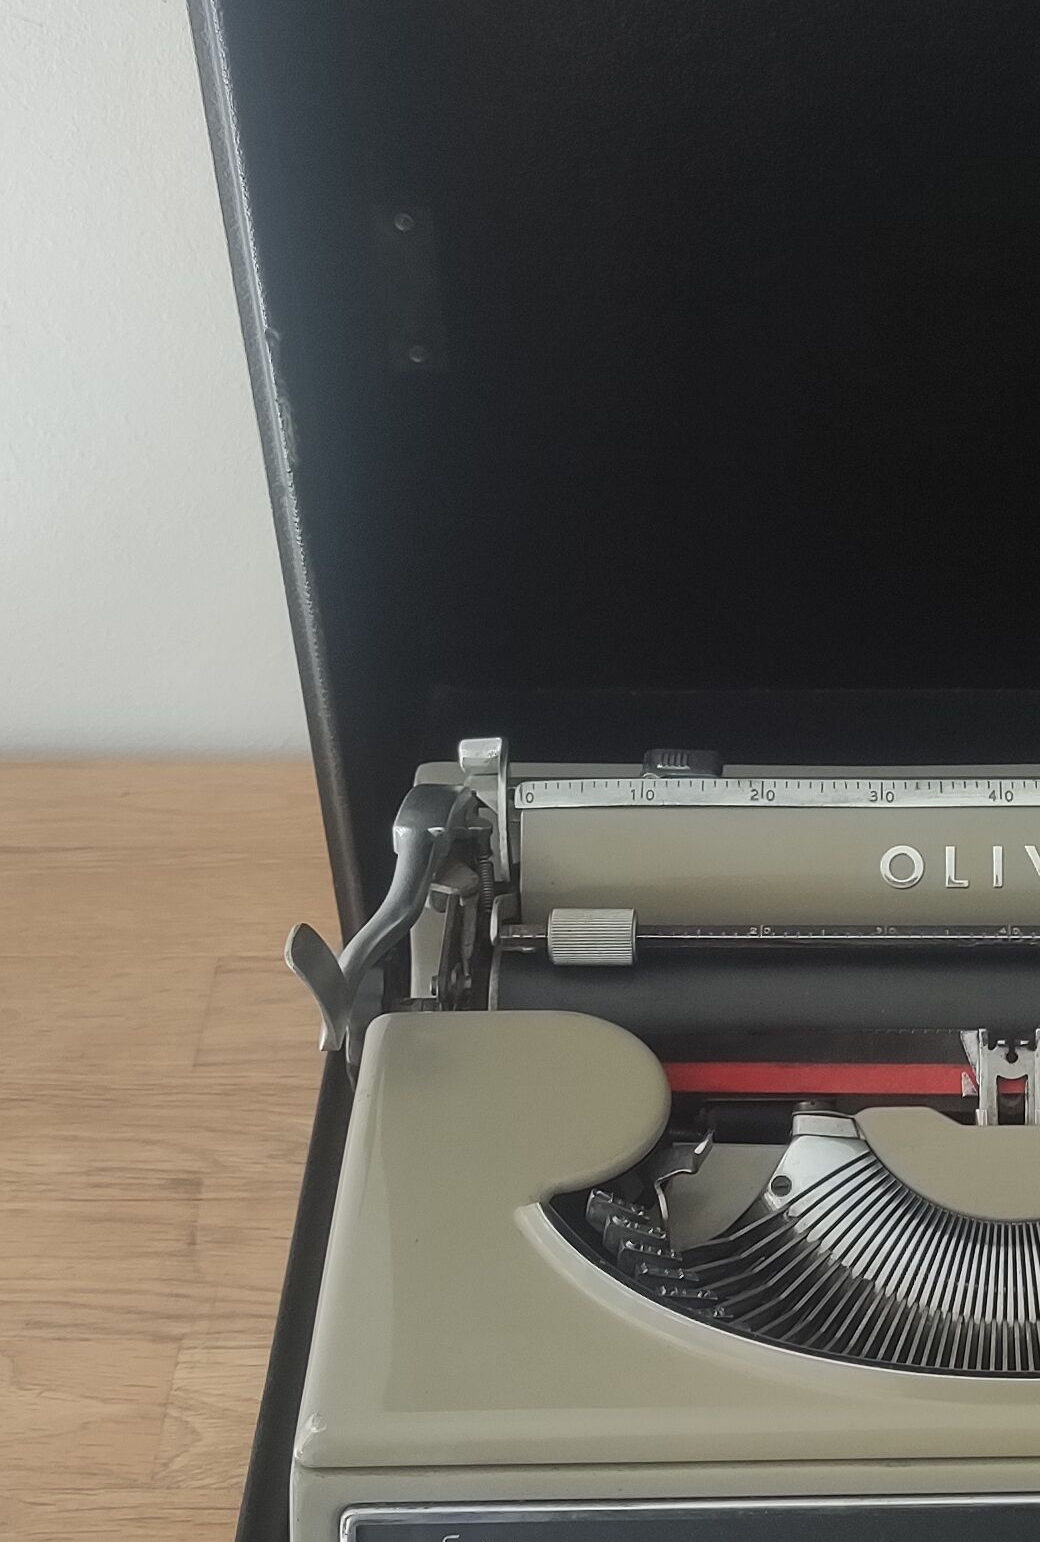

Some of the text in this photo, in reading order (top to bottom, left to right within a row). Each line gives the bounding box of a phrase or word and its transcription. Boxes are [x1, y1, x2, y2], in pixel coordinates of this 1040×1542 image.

[526, 792, 534, 803] 0
[631, 788, 654, 801] 10
[751, 788, 775, 801] 20
[869, 788, 895, 803] 30
[988, 788, 1013, 802] 40
